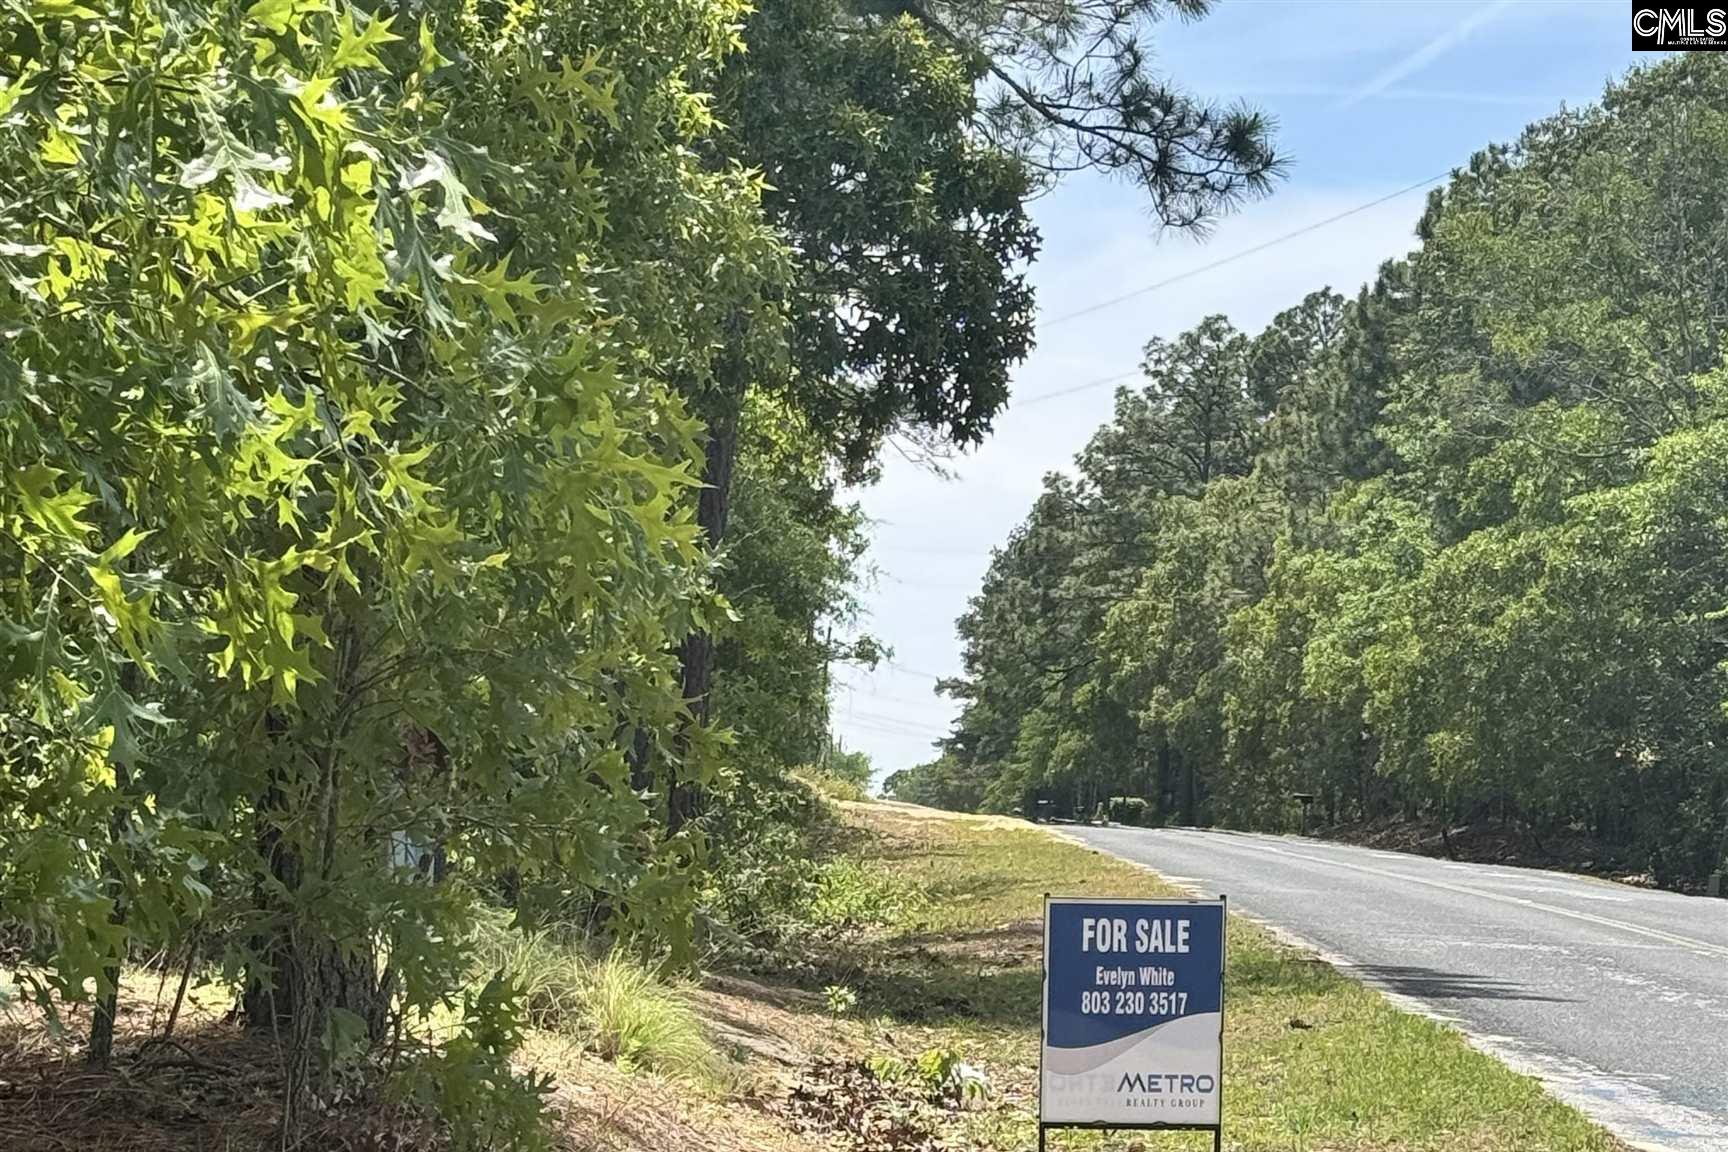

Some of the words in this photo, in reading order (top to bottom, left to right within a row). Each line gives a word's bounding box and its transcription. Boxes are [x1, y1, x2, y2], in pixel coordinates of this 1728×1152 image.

[1082, 918, 1128, 953] FOR
[1135, 919, 1190, 954] SALE
[1095, 966, 1136, 989] Evelyn
[1139, 967, 1175, 986] White
[1081, 991, 1111, 1014] 803
[1115, 991, 1145, 1015] 230
[1149, 992, 1188, 1016] 3517
[1116, 1072, 1215, 1093] METRO
[1126, 1098, 1165, 1108] REALTY
[1170, 1098, 1206, 1108] GROUP
